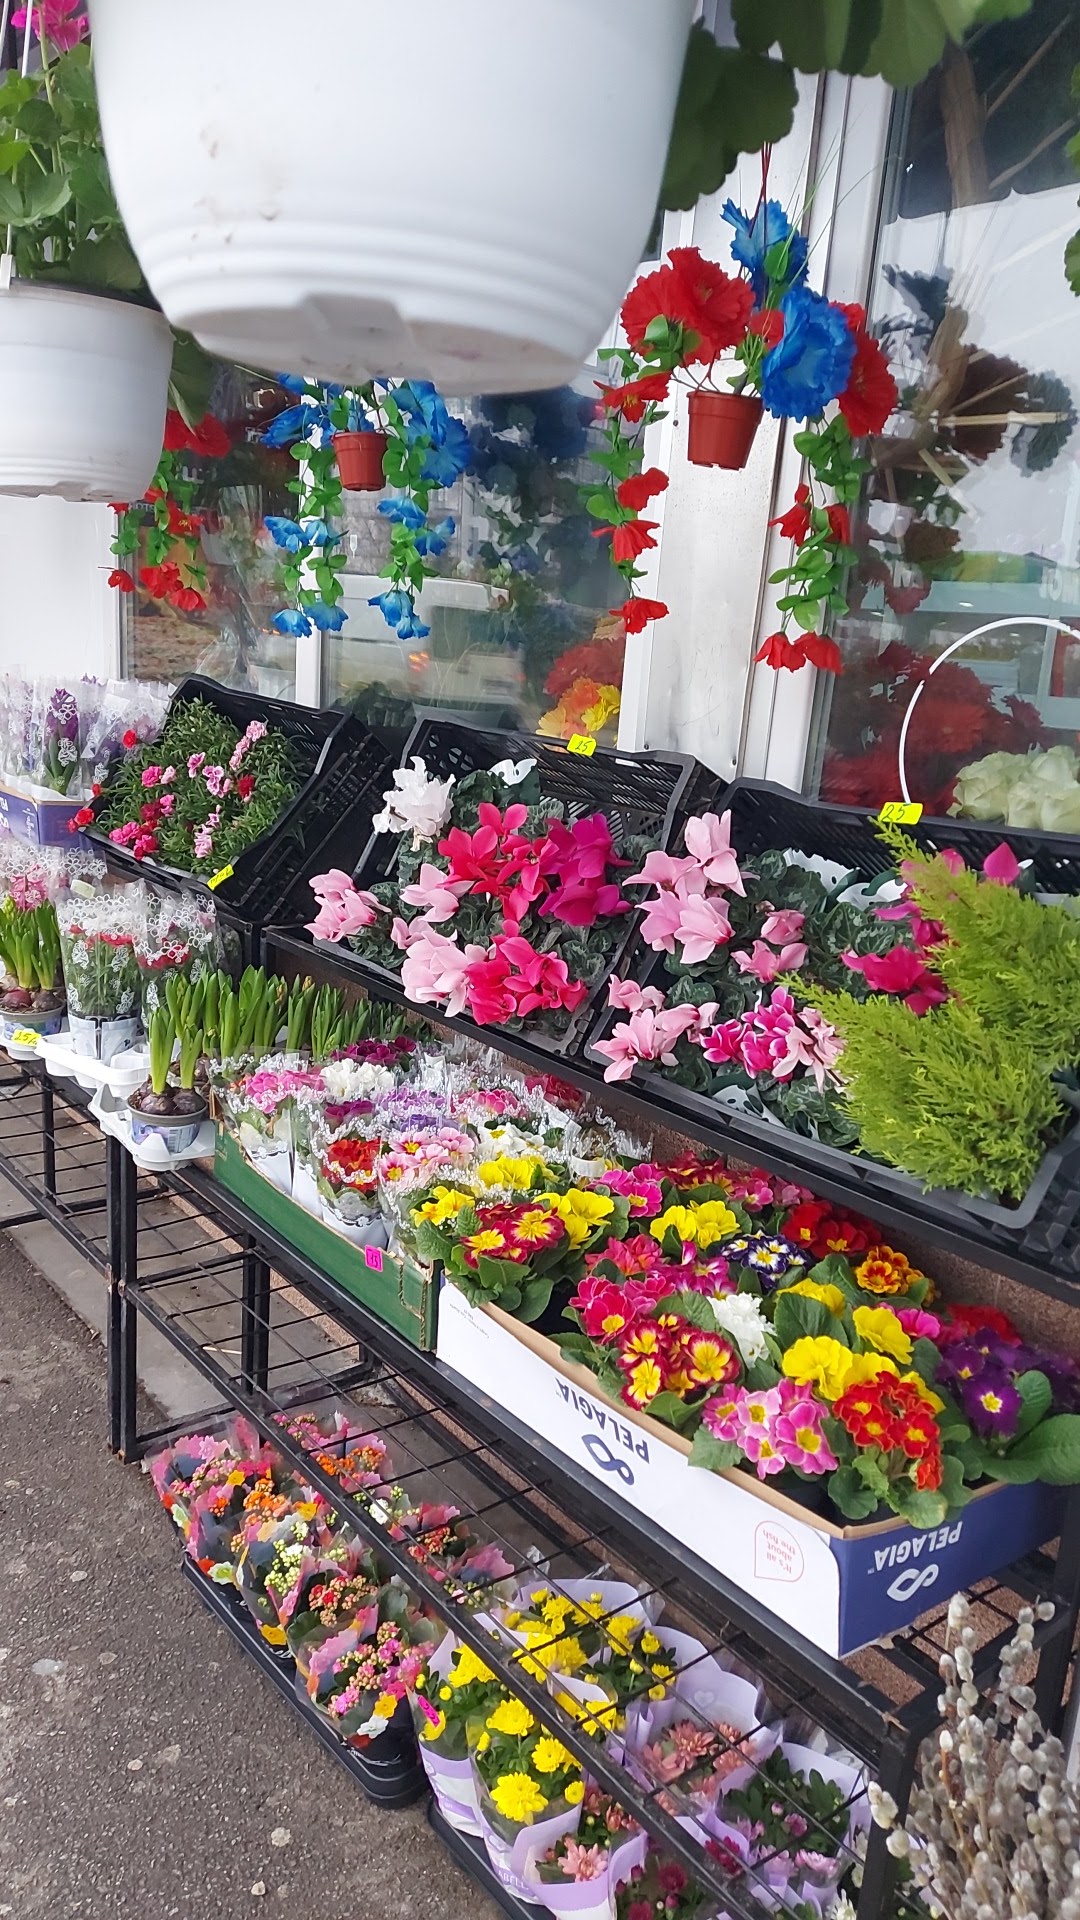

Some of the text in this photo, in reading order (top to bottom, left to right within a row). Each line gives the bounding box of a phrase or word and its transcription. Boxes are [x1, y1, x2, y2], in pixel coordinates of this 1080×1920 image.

[881, 803, 910, 821] 25
[763, 1529, 796, 1556] the fish
[767, 1541, 793, 1562] about
